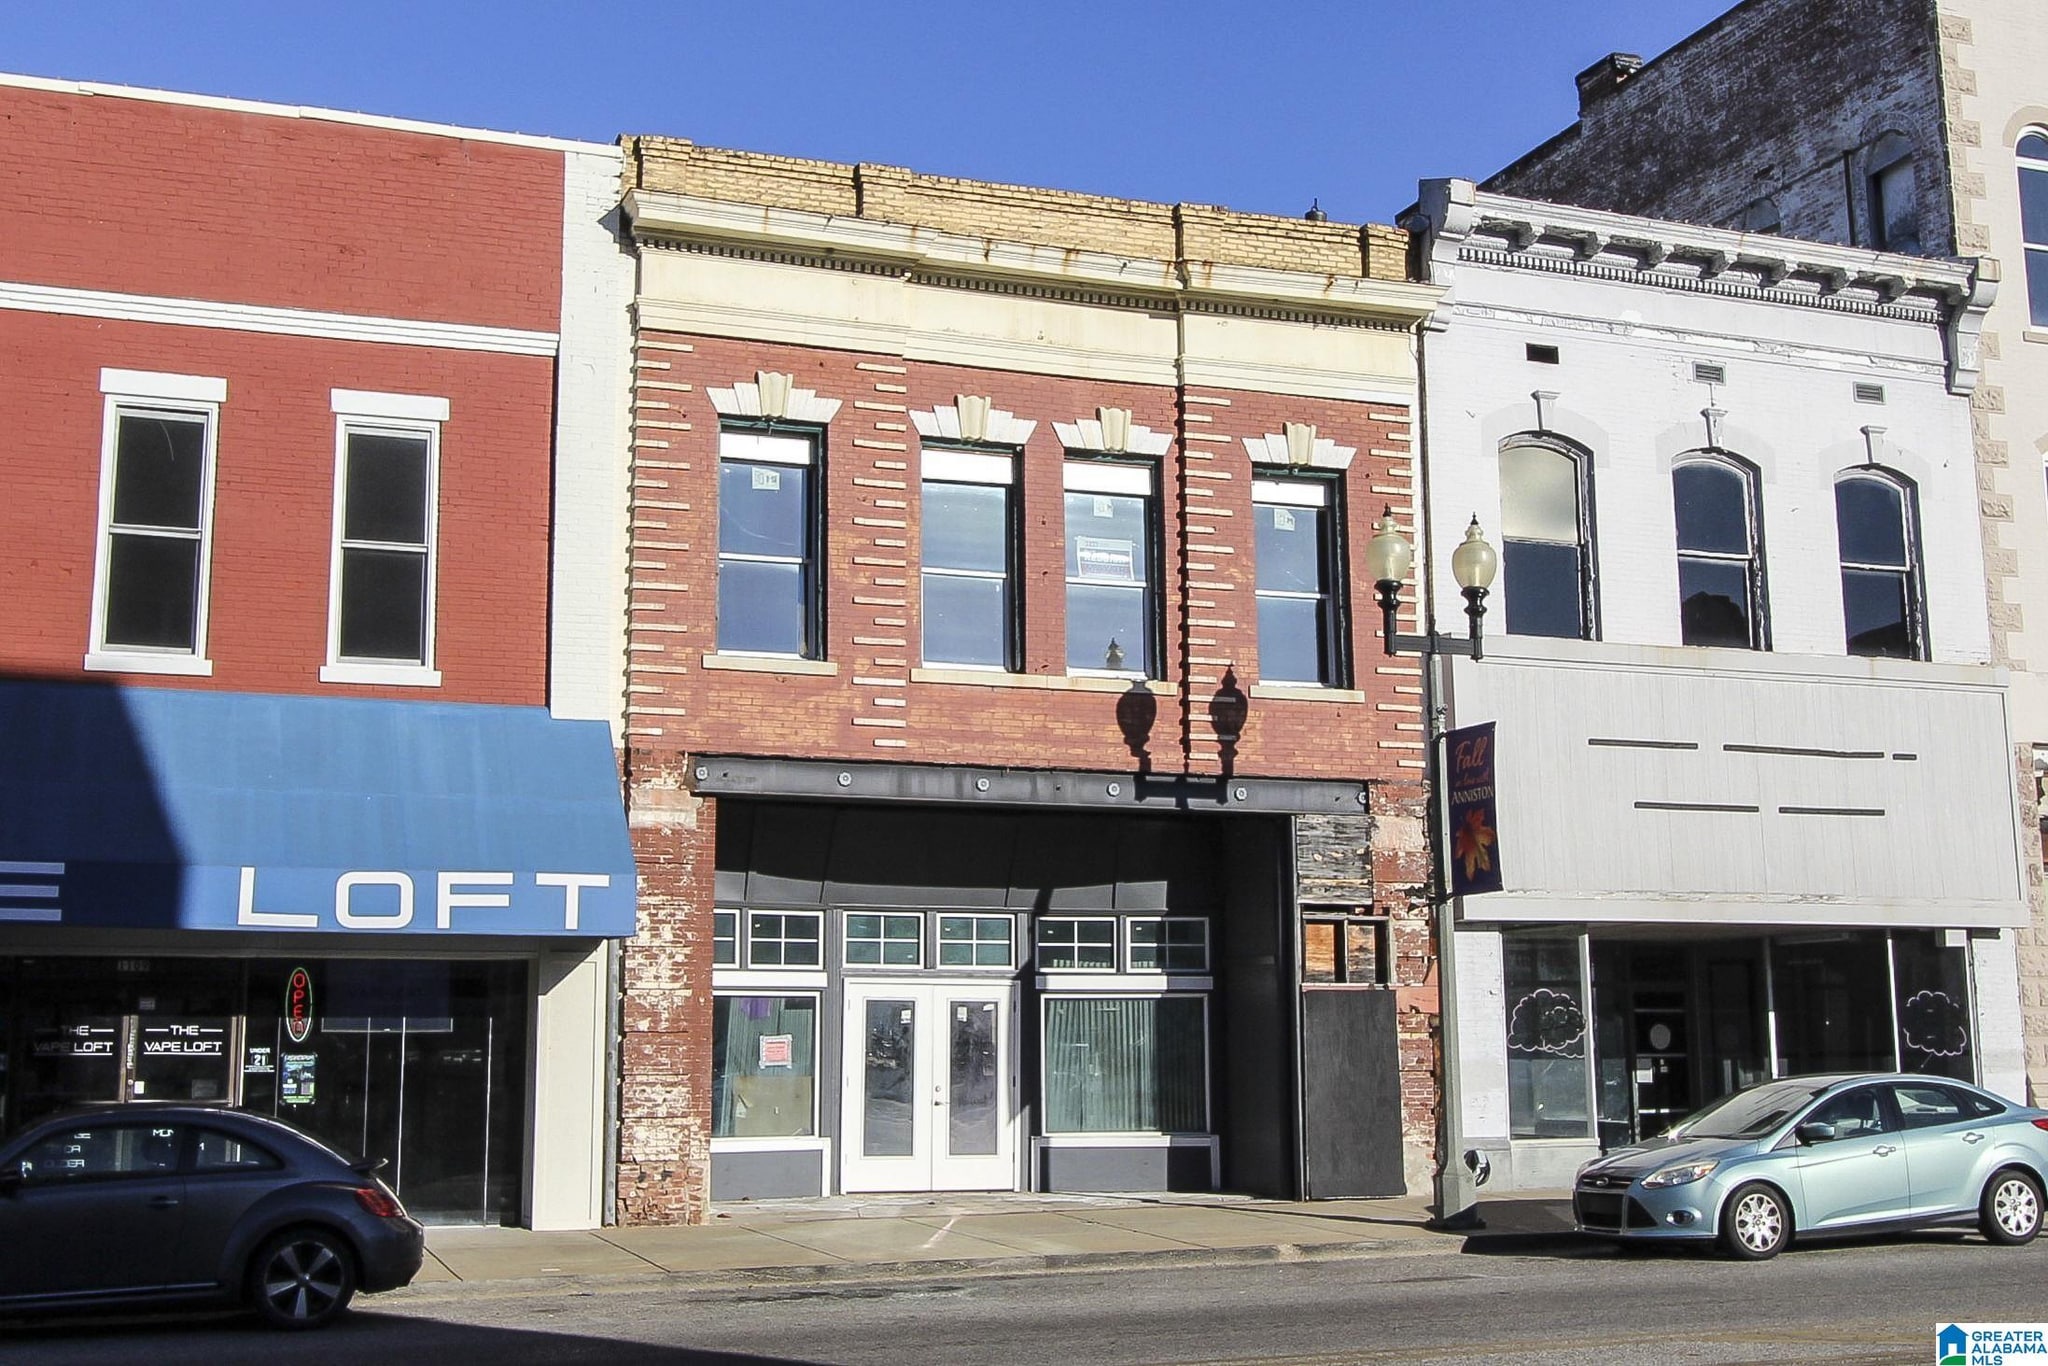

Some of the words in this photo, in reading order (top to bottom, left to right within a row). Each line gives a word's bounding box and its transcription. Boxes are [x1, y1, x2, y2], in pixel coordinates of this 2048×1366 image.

[1455, 736, 1488, 774] Fall
[1451, 785, 1495, 806] ANNISTON
[236, 865, 611, 931] LOFT
[293, 972, 307, 1033] OPEN
[61, 1025, 90, 1036] THE
[170, 1025, 199, 1036] THE
[33, 1041, 71, 1053] VAPE
[73, 1041, 114, 1053] LOFT
[144, 1041, 181, 1052] VAPE
[183, 1041, 222, 1052] LOFT
[254, 1054, 266, 1066] 21
